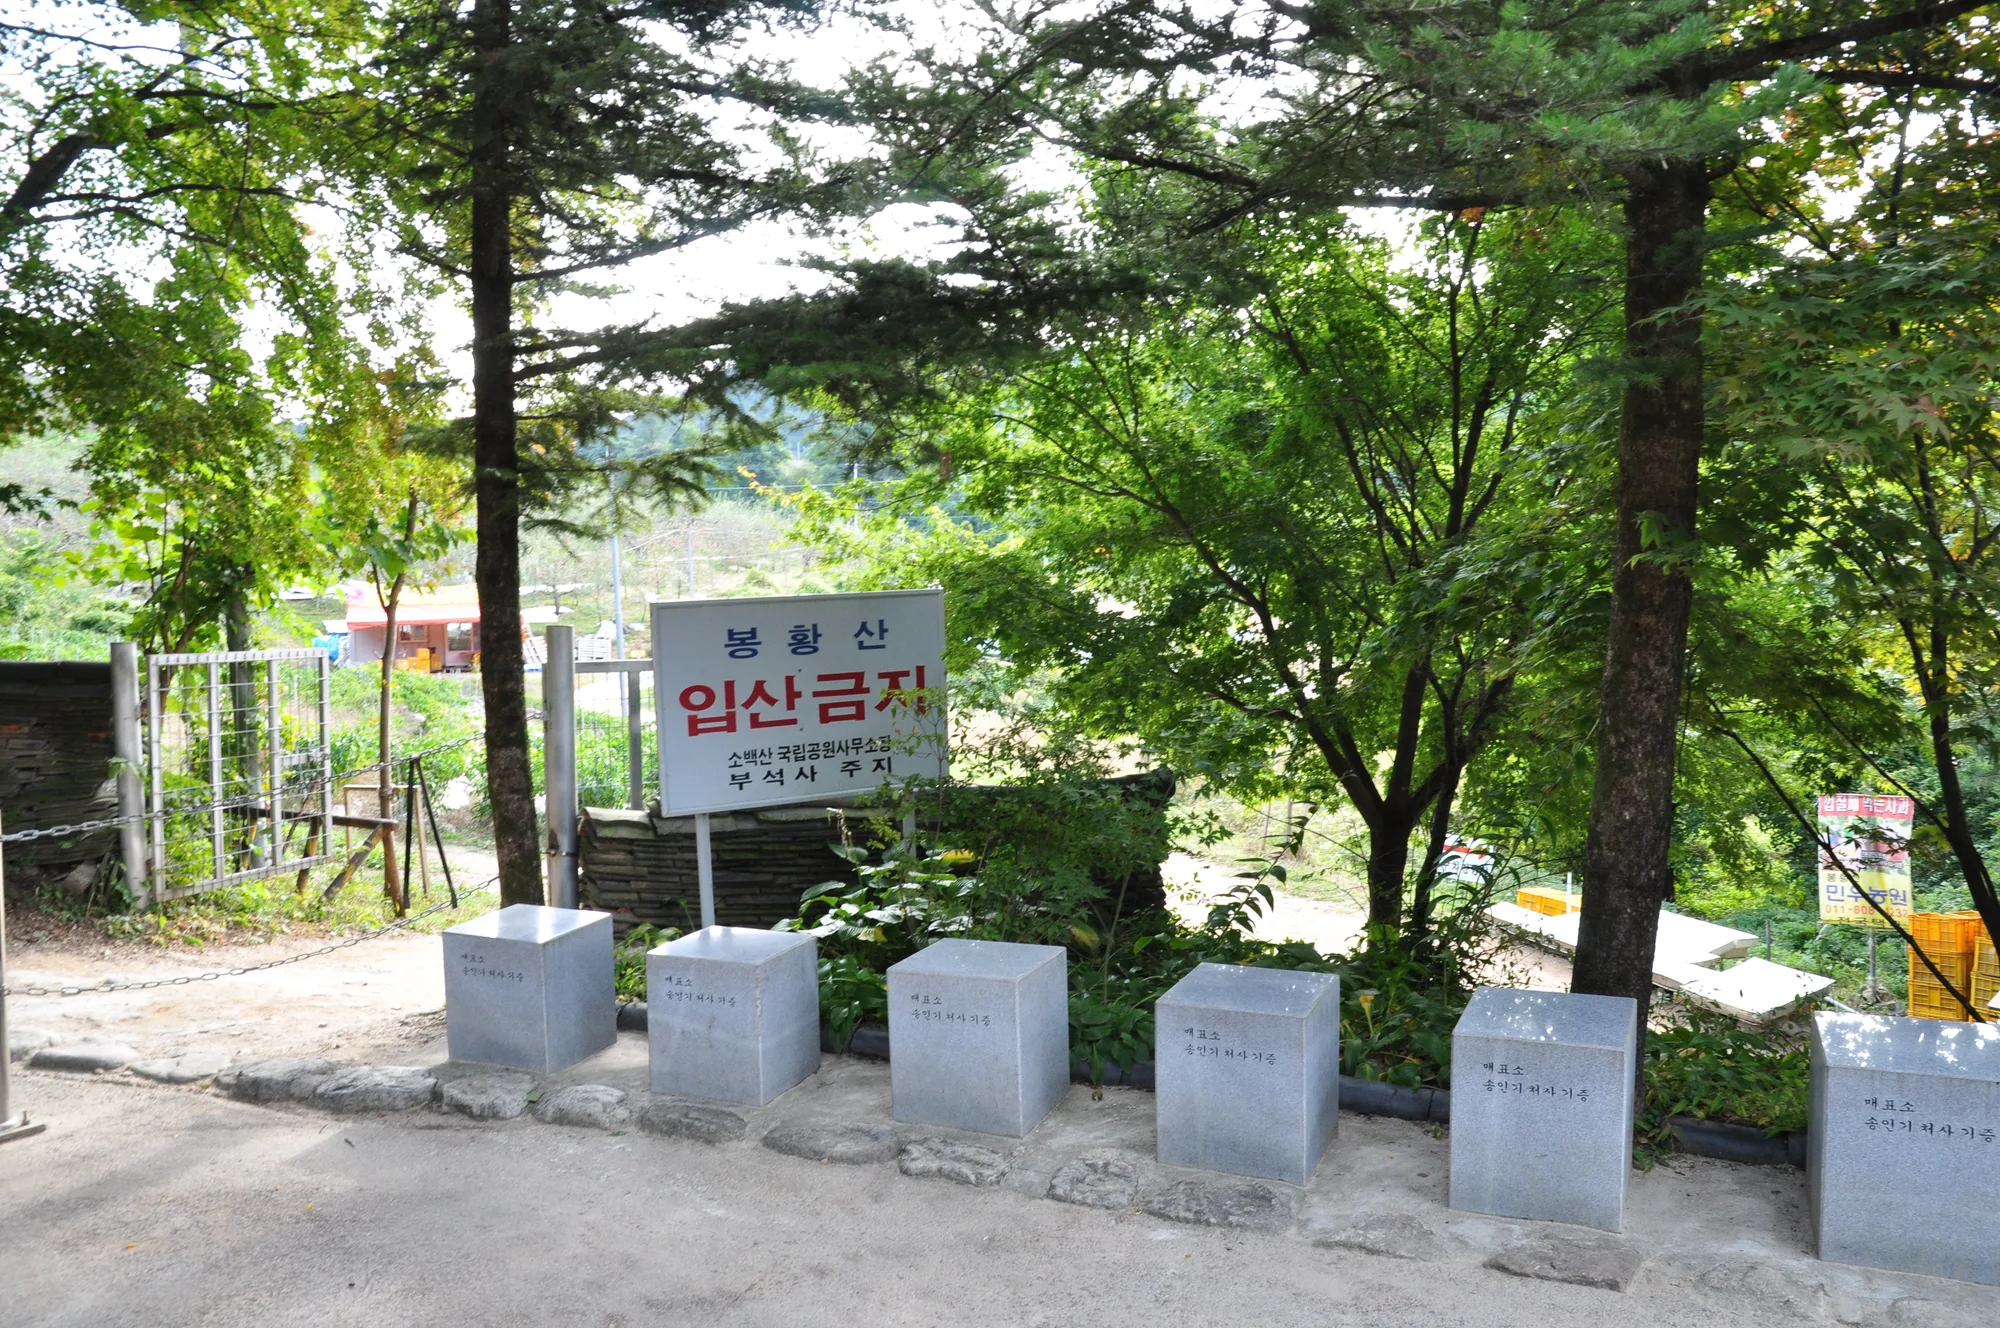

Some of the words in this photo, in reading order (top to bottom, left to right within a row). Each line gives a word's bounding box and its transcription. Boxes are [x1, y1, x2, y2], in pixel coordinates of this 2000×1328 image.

[724, 619, 889, 659] 봉황산
[678, 665, 926, 737] 입산금지
[728, 746, 774, 769] 소백산
[777, 734, 892, 764] 국립공원사무소장
[728, 764, 818, 791] 부석사
[840, 756, 893, 778] 주지
[1826, 884, 1907, 907] 민우농원
[1825, 904, 1909, 919] 011-8084232
[1184, 1027, 1220, 1040] 매표소
[1185, 1044, 1219, 1058] 송인기
[1224, 1049, 1248, 1060] 처사
[1252, 1052, 1276, 1065] 기증
[1483, 1062, 1524, 1076] 매표소
[1483, 1080, 1522, 1094] 송인기
[1529, 1084, 1556, 1097] 처사
[1562, 1087, 1589, 1102] 기증
[1864, 1097, 1915, 1112] 매표소
[1865, 1117, 1912, 1132] 송인기
[1920, 1122, 1954, 1137] 처사
[1961, 1126, 1995, 1142] 기증
